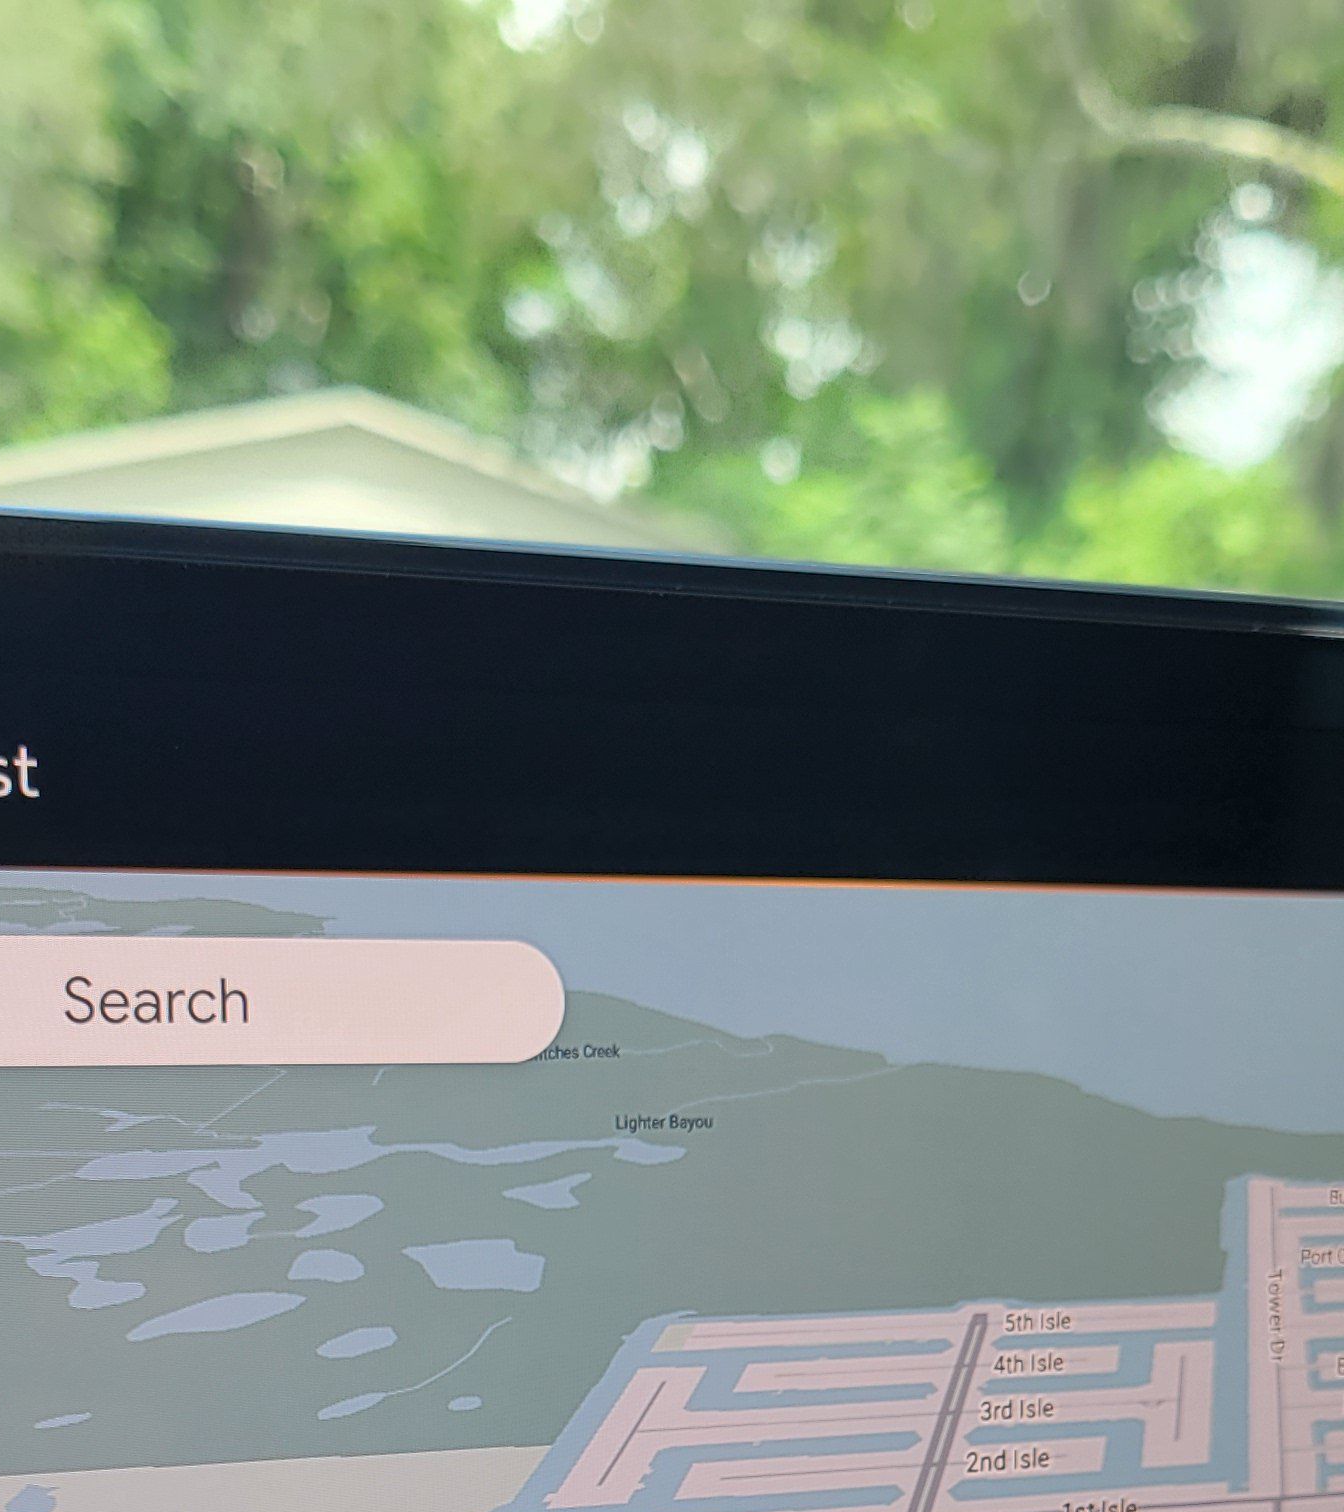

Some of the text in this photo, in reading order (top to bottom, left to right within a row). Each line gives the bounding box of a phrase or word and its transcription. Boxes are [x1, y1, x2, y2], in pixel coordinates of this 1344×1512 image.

[64, 975, 249, 1023] Search
[583, 1043, 620, 1059] Creek
[615, 1114, 713, 1133] Lighter Bayou
[1301, 1250, 1332, 1264] Port
[1005, 1312, 1071, 1332] 5th Isle
[1268, 1269, 1285, 1362] Tower Dr
[994, 1353, 1064, 1373] 4th Isle
[981, 1398, 1054, 1421] 3rd Isle
[967, 1448, 1050, 1472] 2nd Isle
